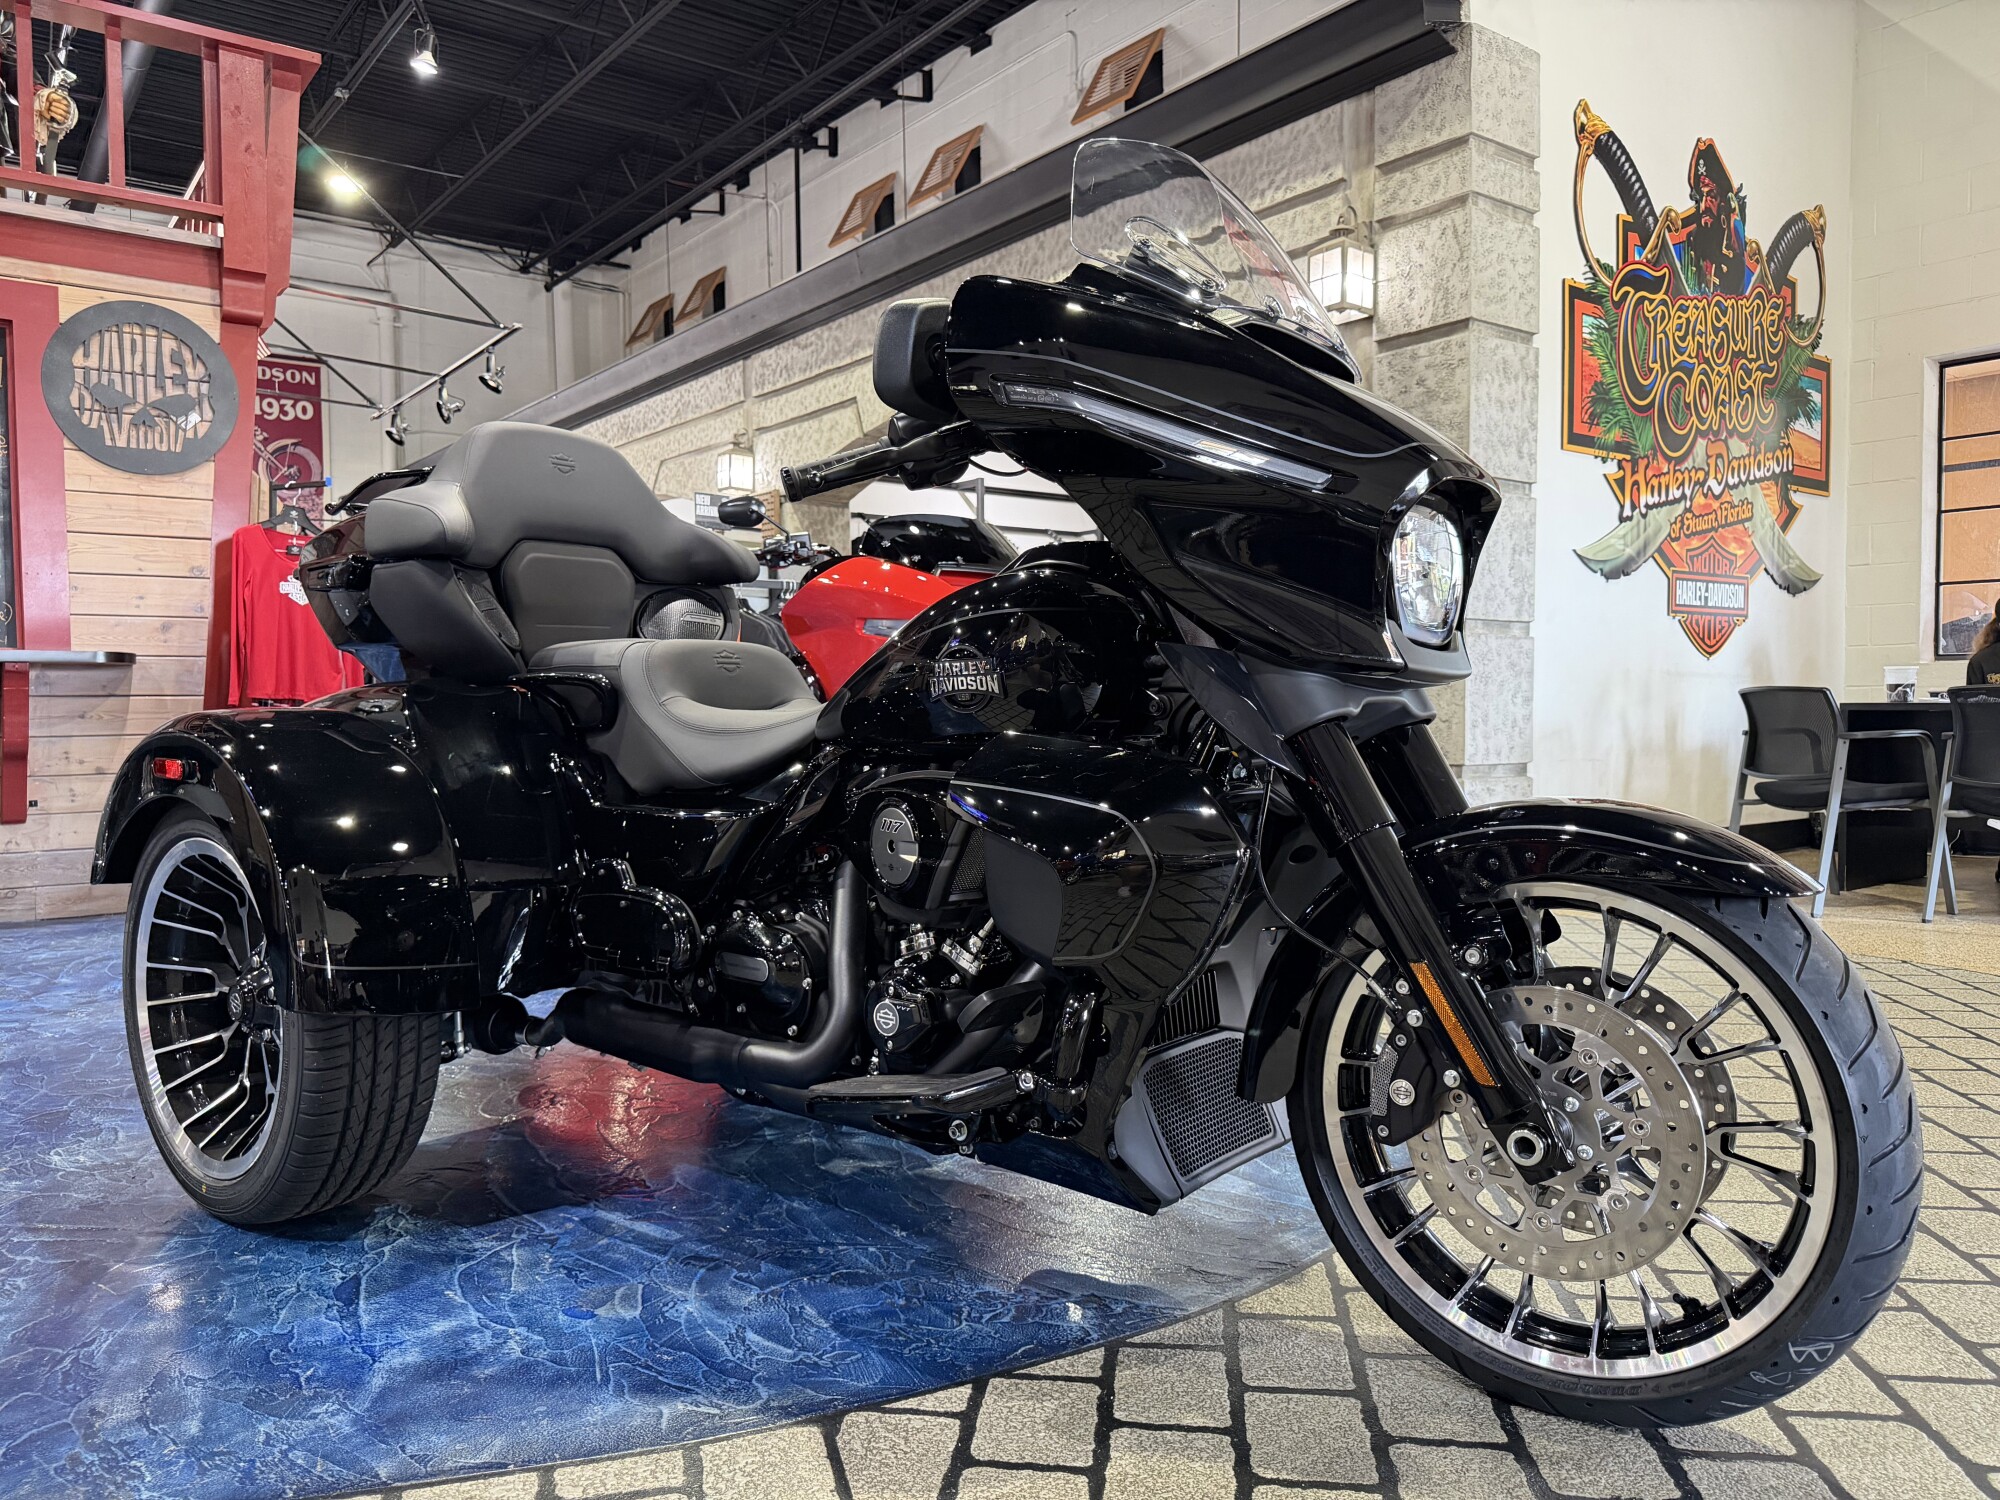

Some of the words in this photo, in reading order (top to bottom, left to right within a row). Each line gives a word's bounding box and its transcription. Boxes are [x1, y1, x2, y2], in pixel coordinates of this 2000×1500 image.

[1611, 264, 1787, 412] TREASURE
[72, 322, 211, 406] HARLEY
[257, 366, 316, 386] DSON
[254, 395, 314, 421] 1930
[1654, 360, 1778, 461] COAST
[1621, 437, 1794, 518] Harley-Davidson
[695, 505, 719, 517] ARRIV
[1670, 516, 1682, 538] of
[1683, 510, 1718, 535] Stuart,
[1720, 499, 1753, 525] Florida
[1693, 547, 1731, 576] MOTOR
[1676, 580, 1745, 609] HARLEY-DAVIDSON
[1692, 615, 1729, 646] CYCLES
[934, 660, 990, 677] HARLEY-
[929, 673, 1000, 698] DAVIDSON
[880, 817, 906, 834] 117
[896, 1004, 911, 1012] VVT
